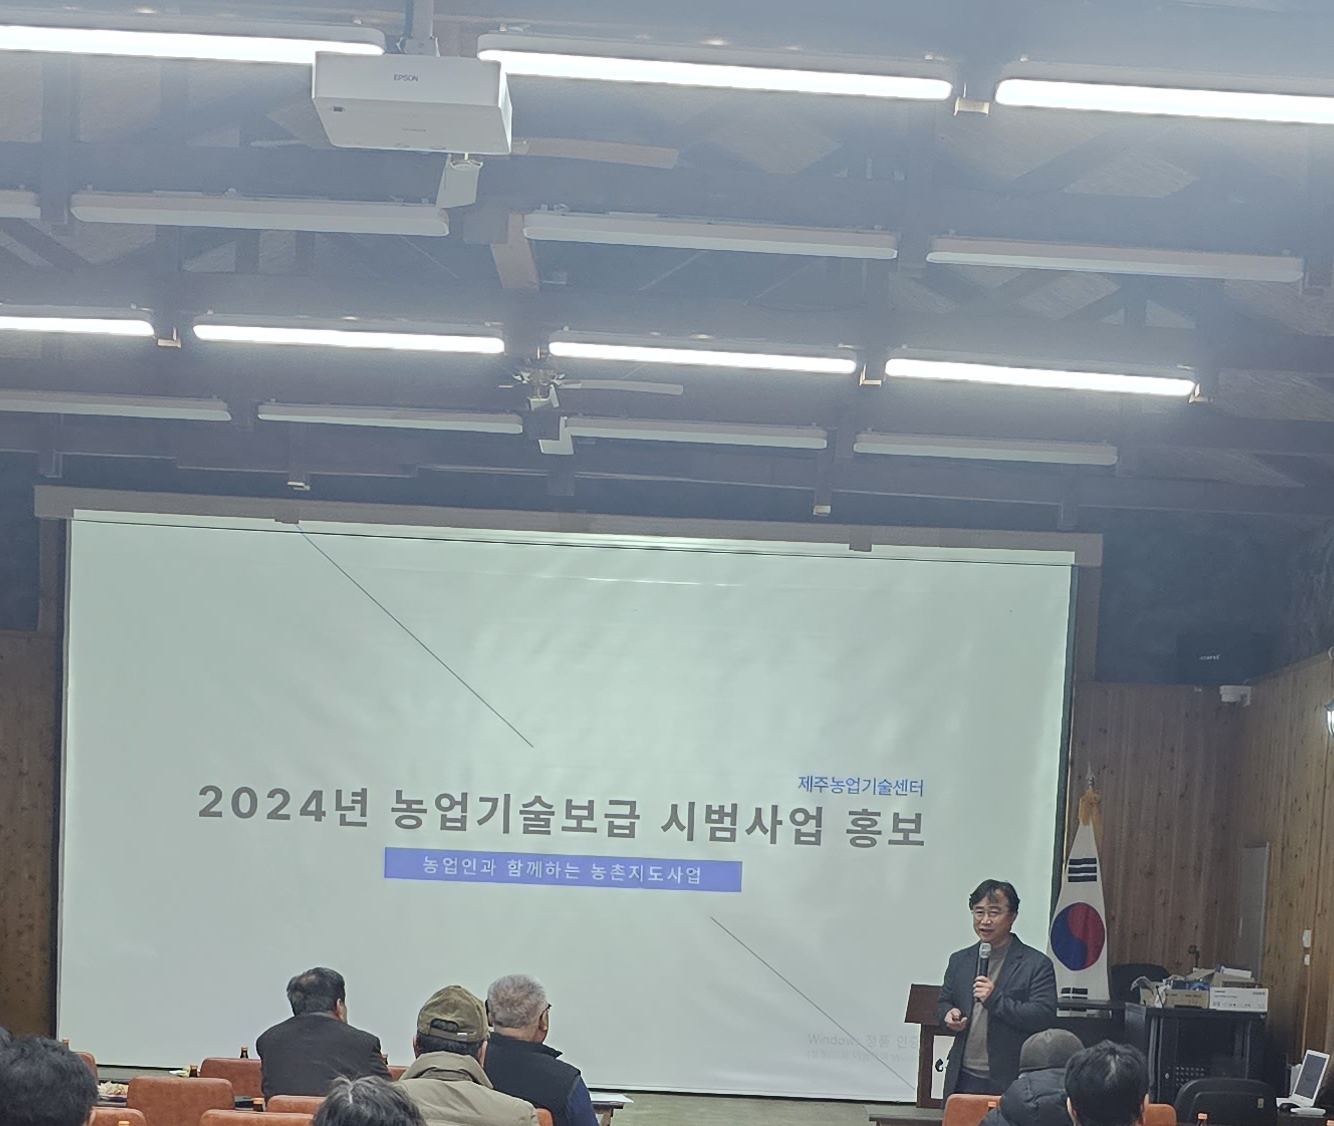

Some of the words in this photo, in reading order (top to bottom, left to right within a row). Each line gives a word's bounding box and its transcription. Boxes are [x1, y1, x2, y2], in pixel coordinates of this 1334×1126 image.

[393, 73, 419, 82] EPSON
[797, 775, 924, 797] 제주농업기술센터
[198, 785, 368, 827] 2024년
[390, 789, 641, 839] 농업기술보급
[660, 801, 824, 846] 시범사업
[845, 808, 925, 848] 홍보
[422, 855, 497, 877] 농업인과
[507, 858, 581, 880] 함께하는
[590, 863, 701, 885] 농촌지도사업
